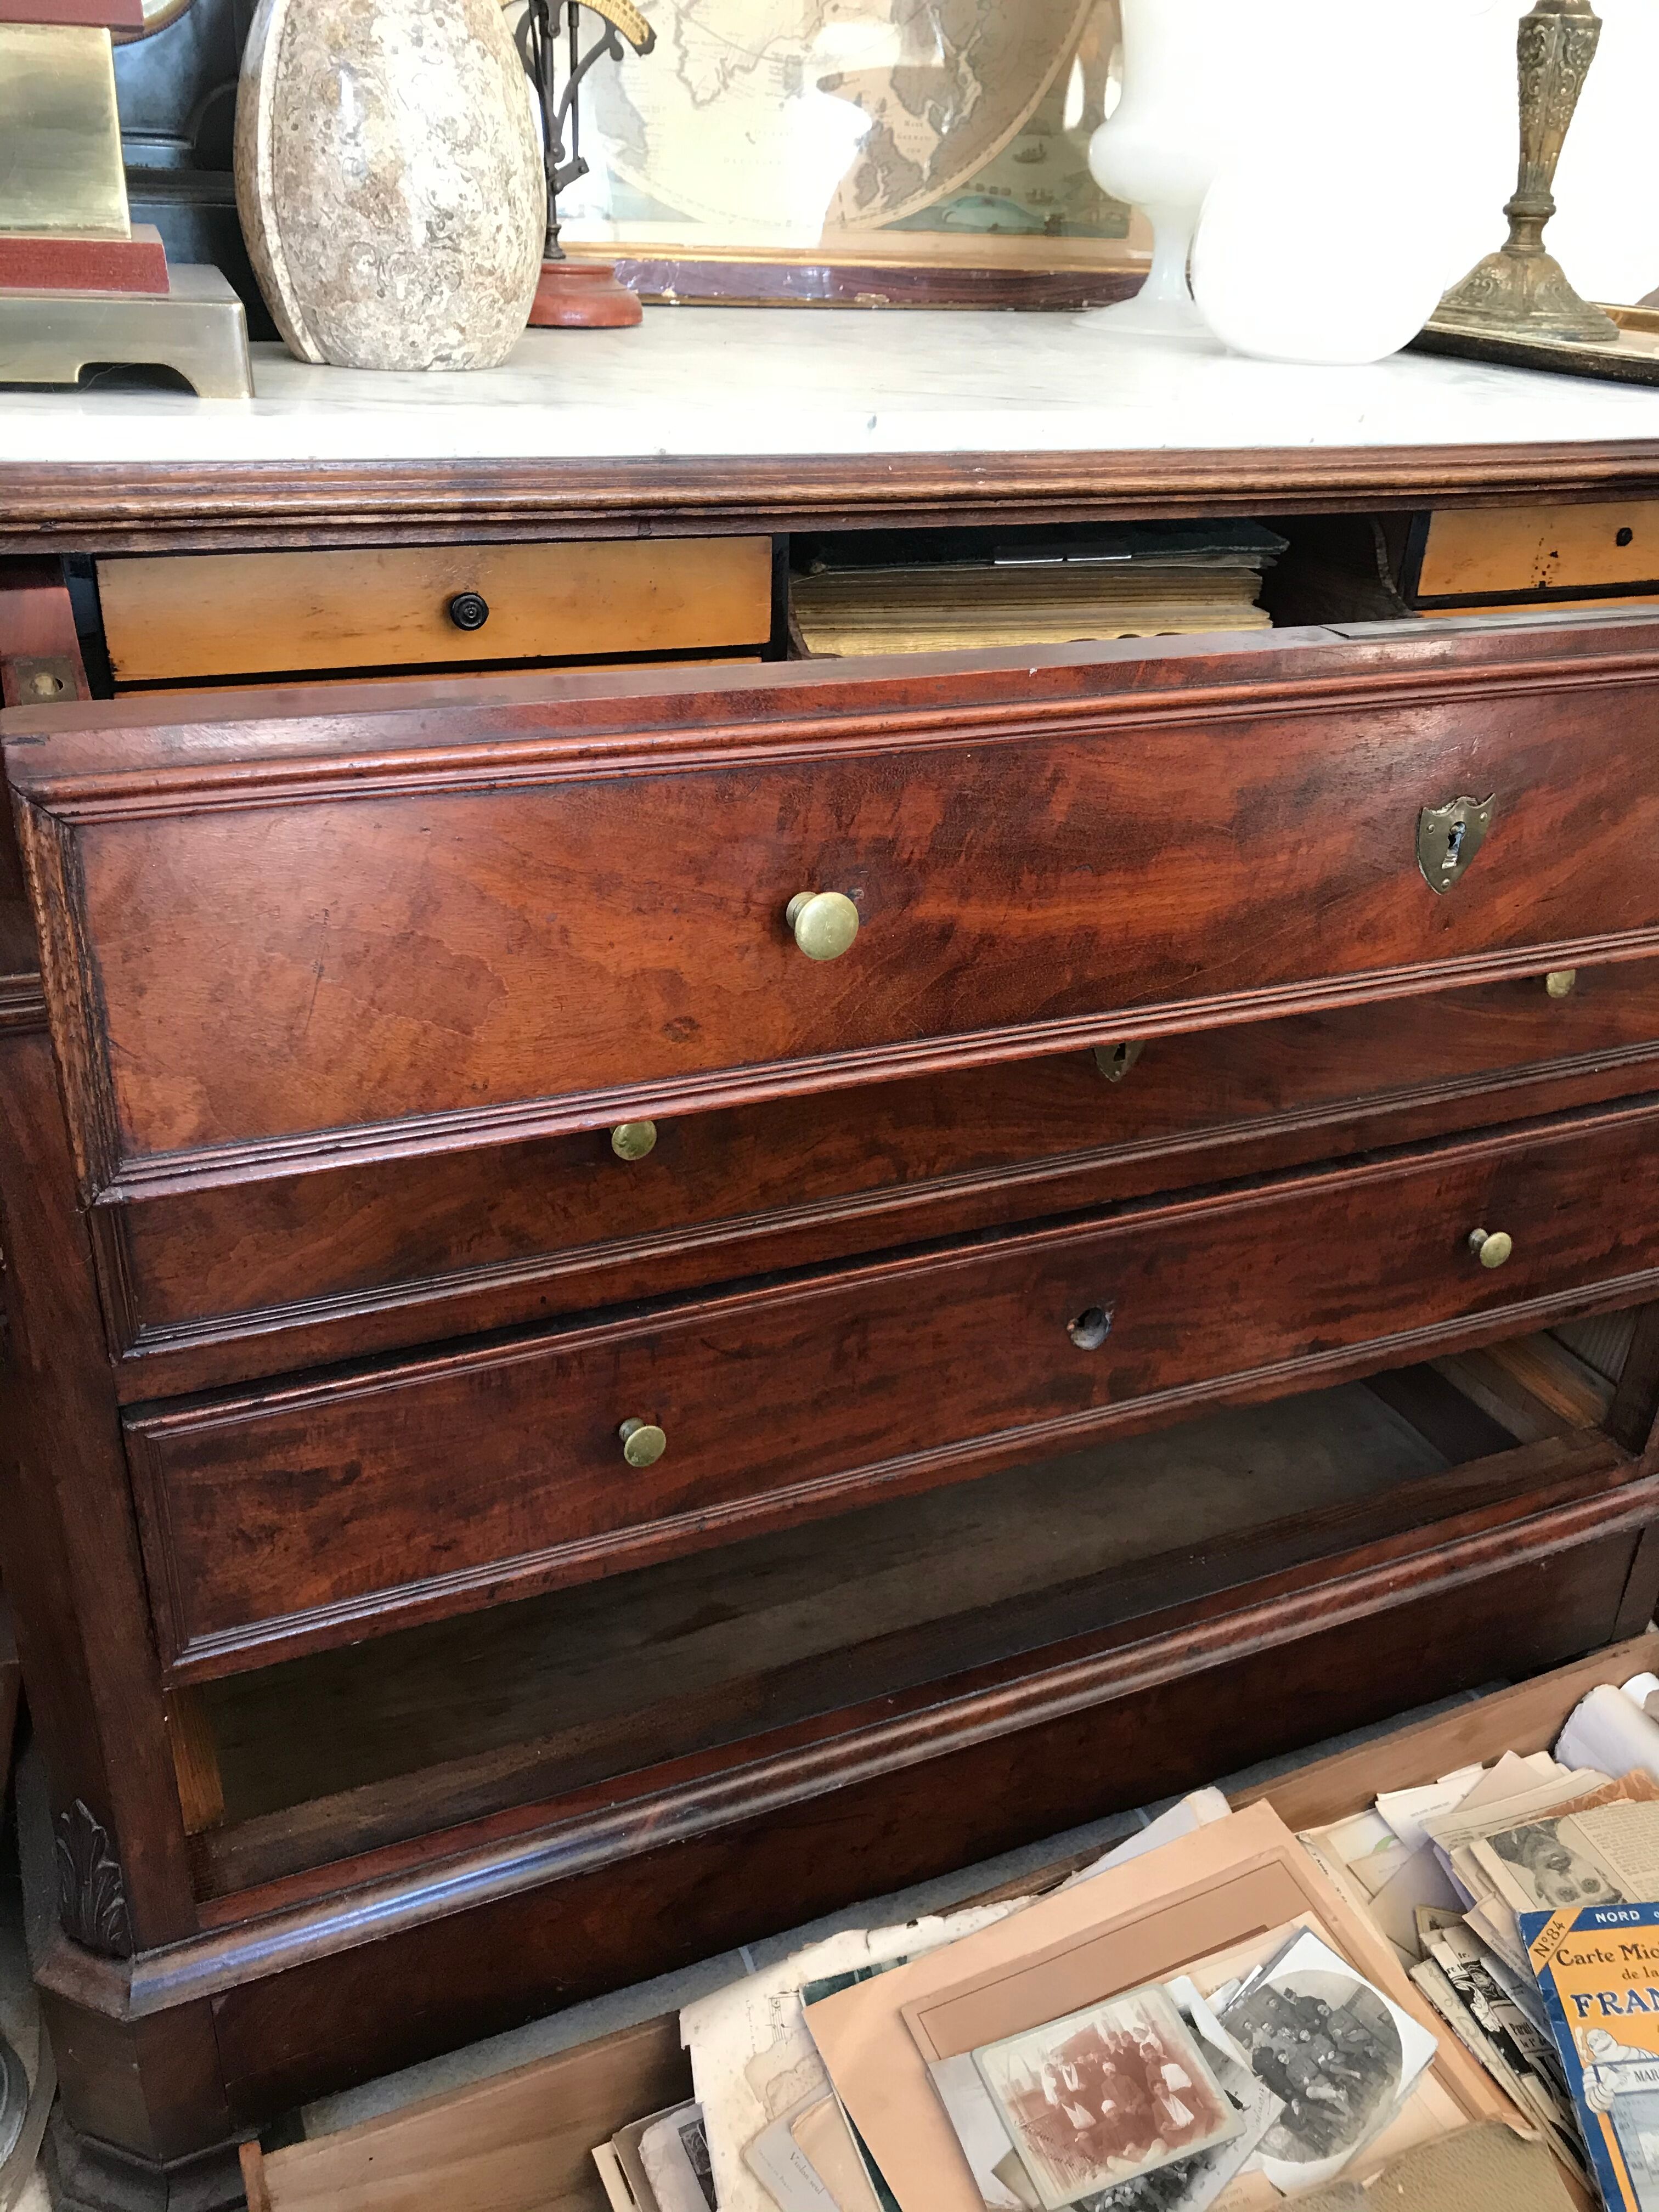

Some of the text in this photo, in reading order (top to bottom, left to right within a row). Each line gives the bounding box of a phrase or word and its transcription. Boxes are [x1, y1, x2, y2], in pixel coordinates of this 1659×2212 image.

[1595, 1910, 1640, 1923] NORD
[1556, 1949, 1615, 1966] Carte
[1622, 1966, 1659, 1980] de la
[790, 2152, 809, 2180] Violon
